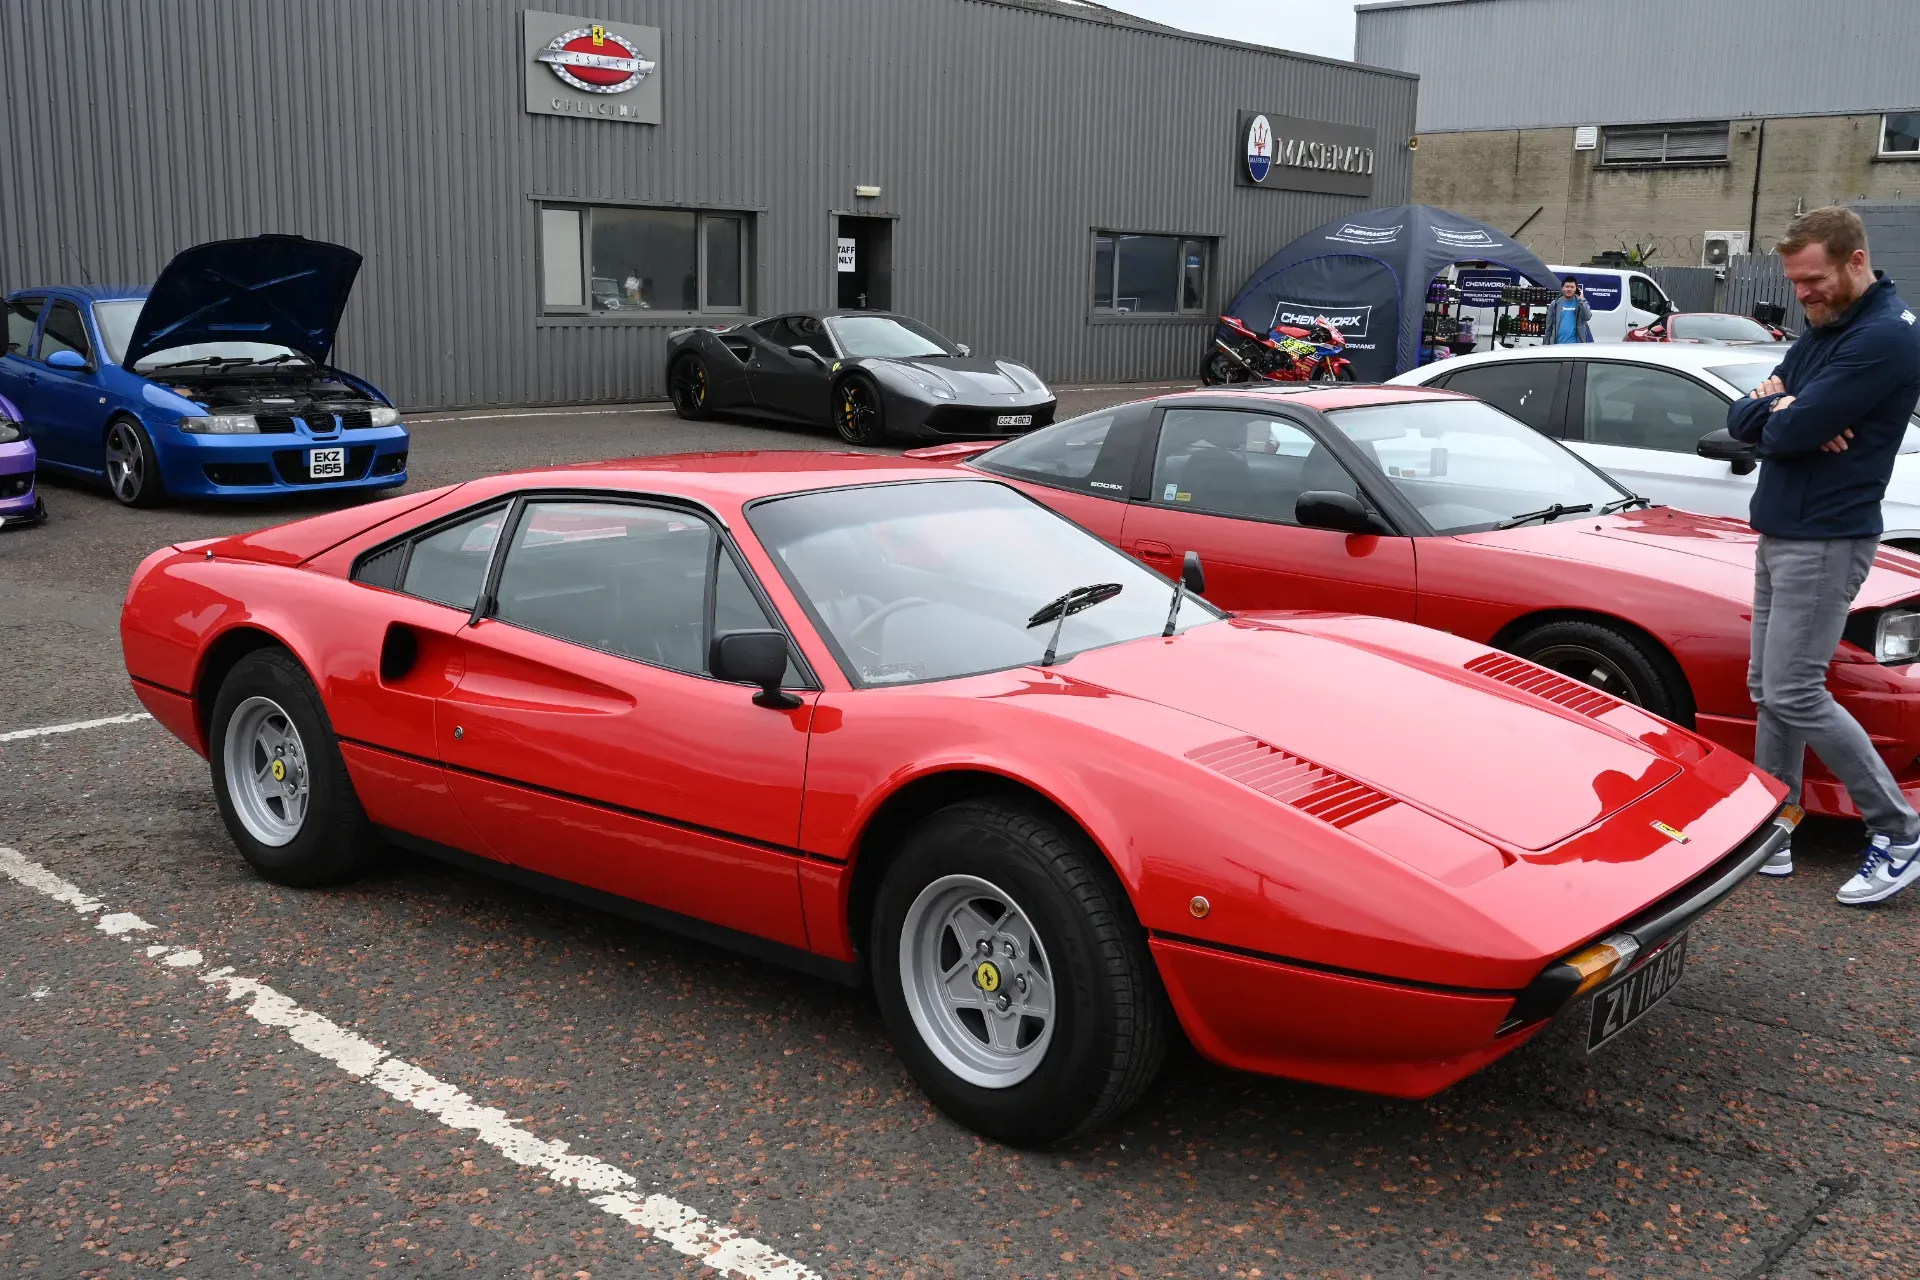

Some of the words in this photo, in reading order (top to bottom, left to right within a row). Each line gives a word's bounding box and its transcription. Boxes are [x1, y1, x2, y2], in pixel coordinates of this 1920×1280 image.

[553, 51, 641, 71] CLASSICHE
[551, 97, 639, 118] OFFICINA
[1275, 138, 1374, 175] MASERATI
[838, 246, 855, 254] TAFF
[838, 256, 853, 264] NLY
[314, 451, 340, 463] EKZ
[313, 463, 342, 475] 6155
[1602, 976, 1636, 1037] ZV
[1638, 943, 1682, 1013] 11419
